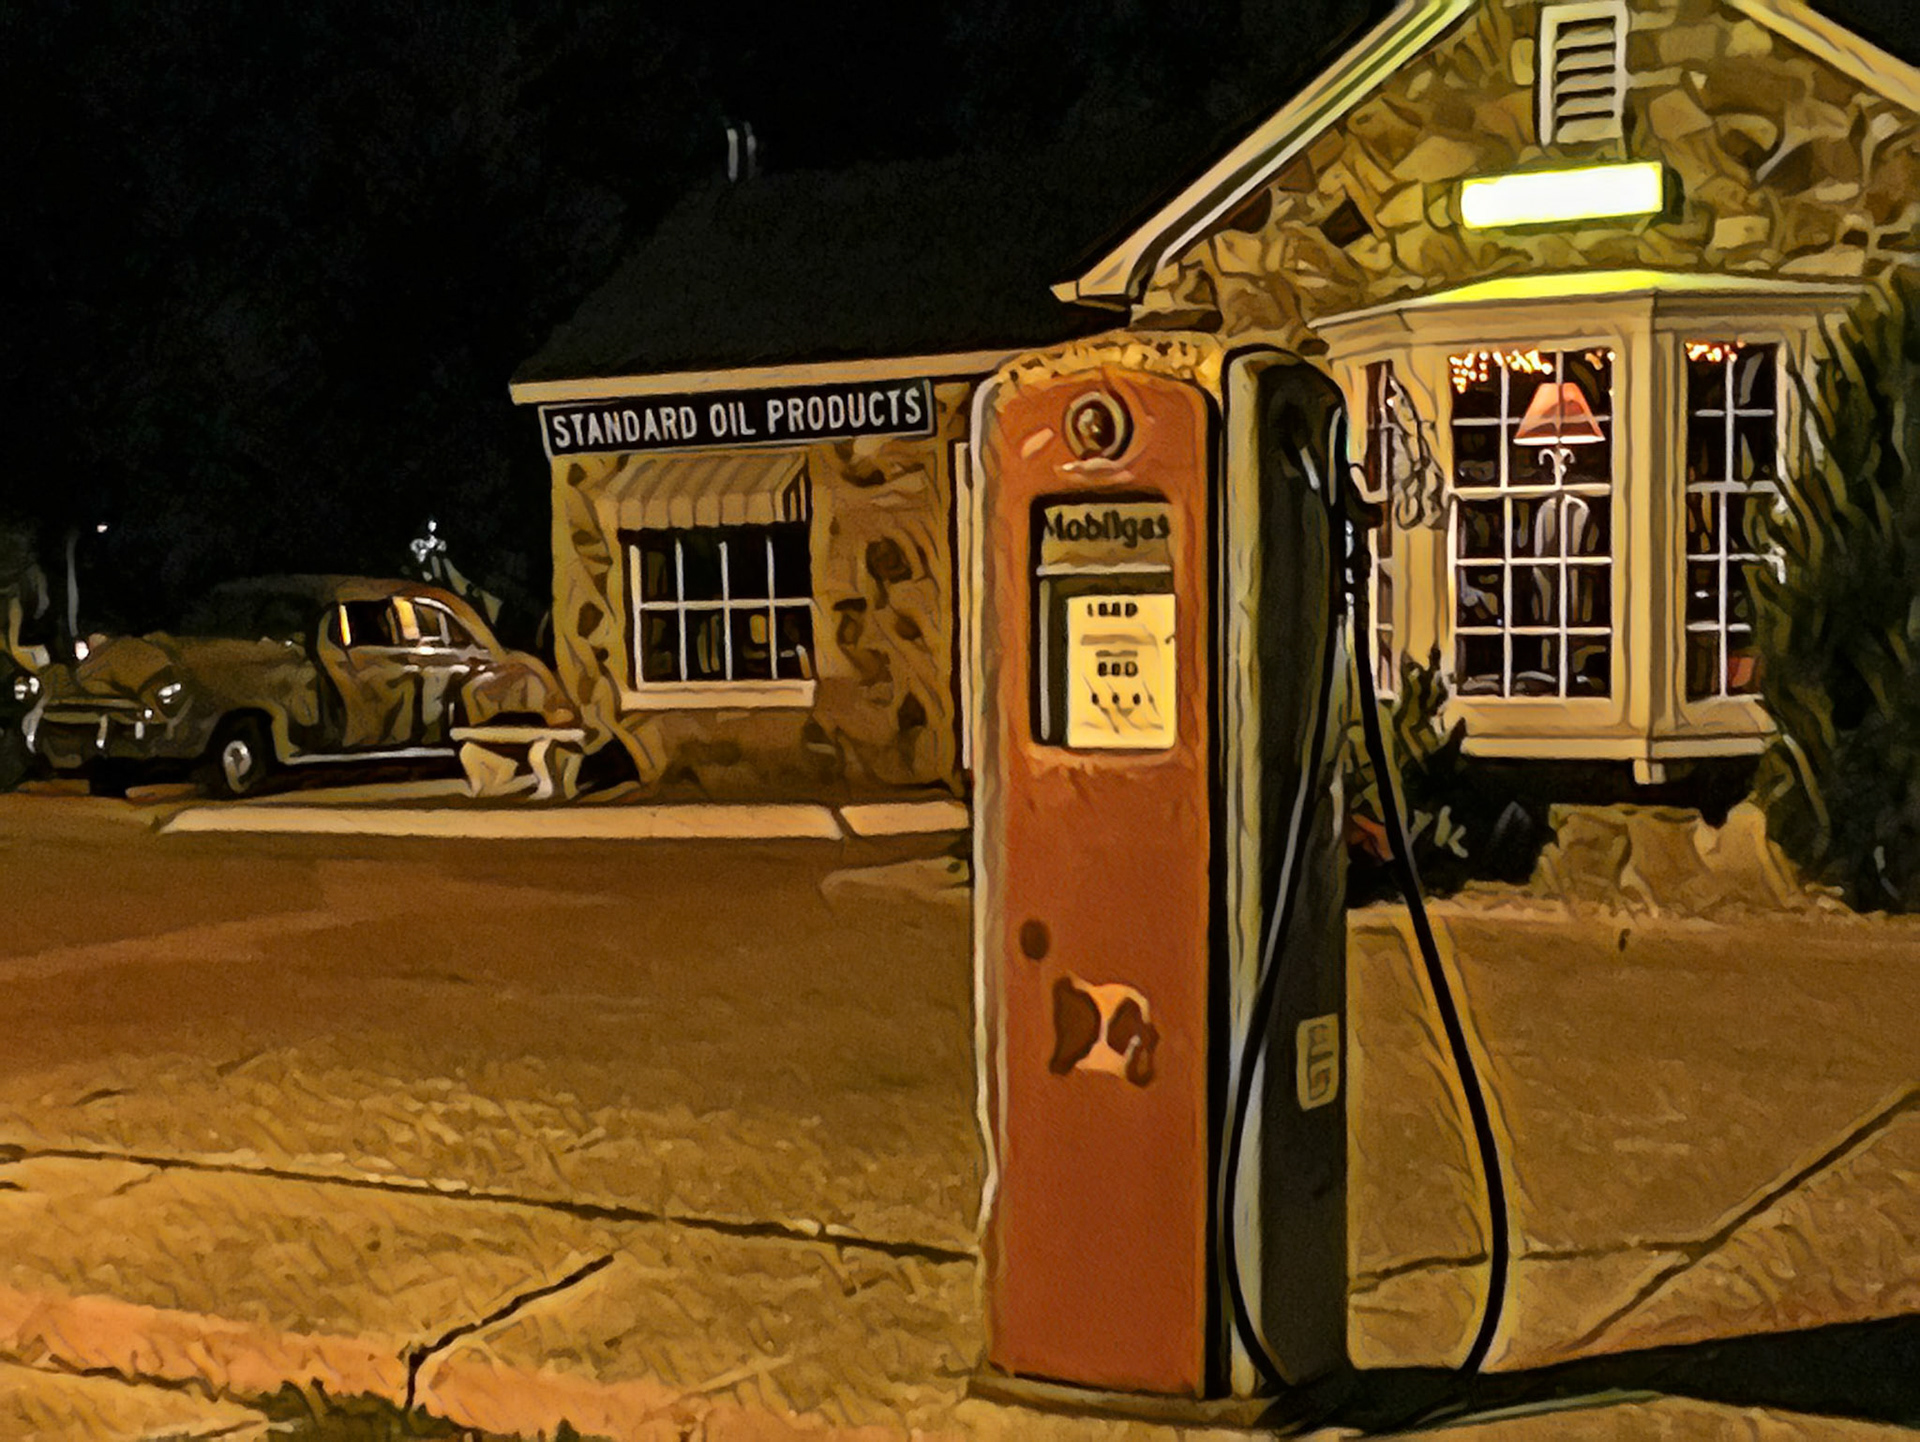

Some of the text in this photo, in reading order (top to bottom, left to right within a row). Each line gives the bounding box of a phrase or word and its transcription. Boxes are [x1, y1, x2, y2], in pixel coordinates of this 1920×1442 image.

[553, 387, 922, 448] STANDARD OIL PRODUCTS
